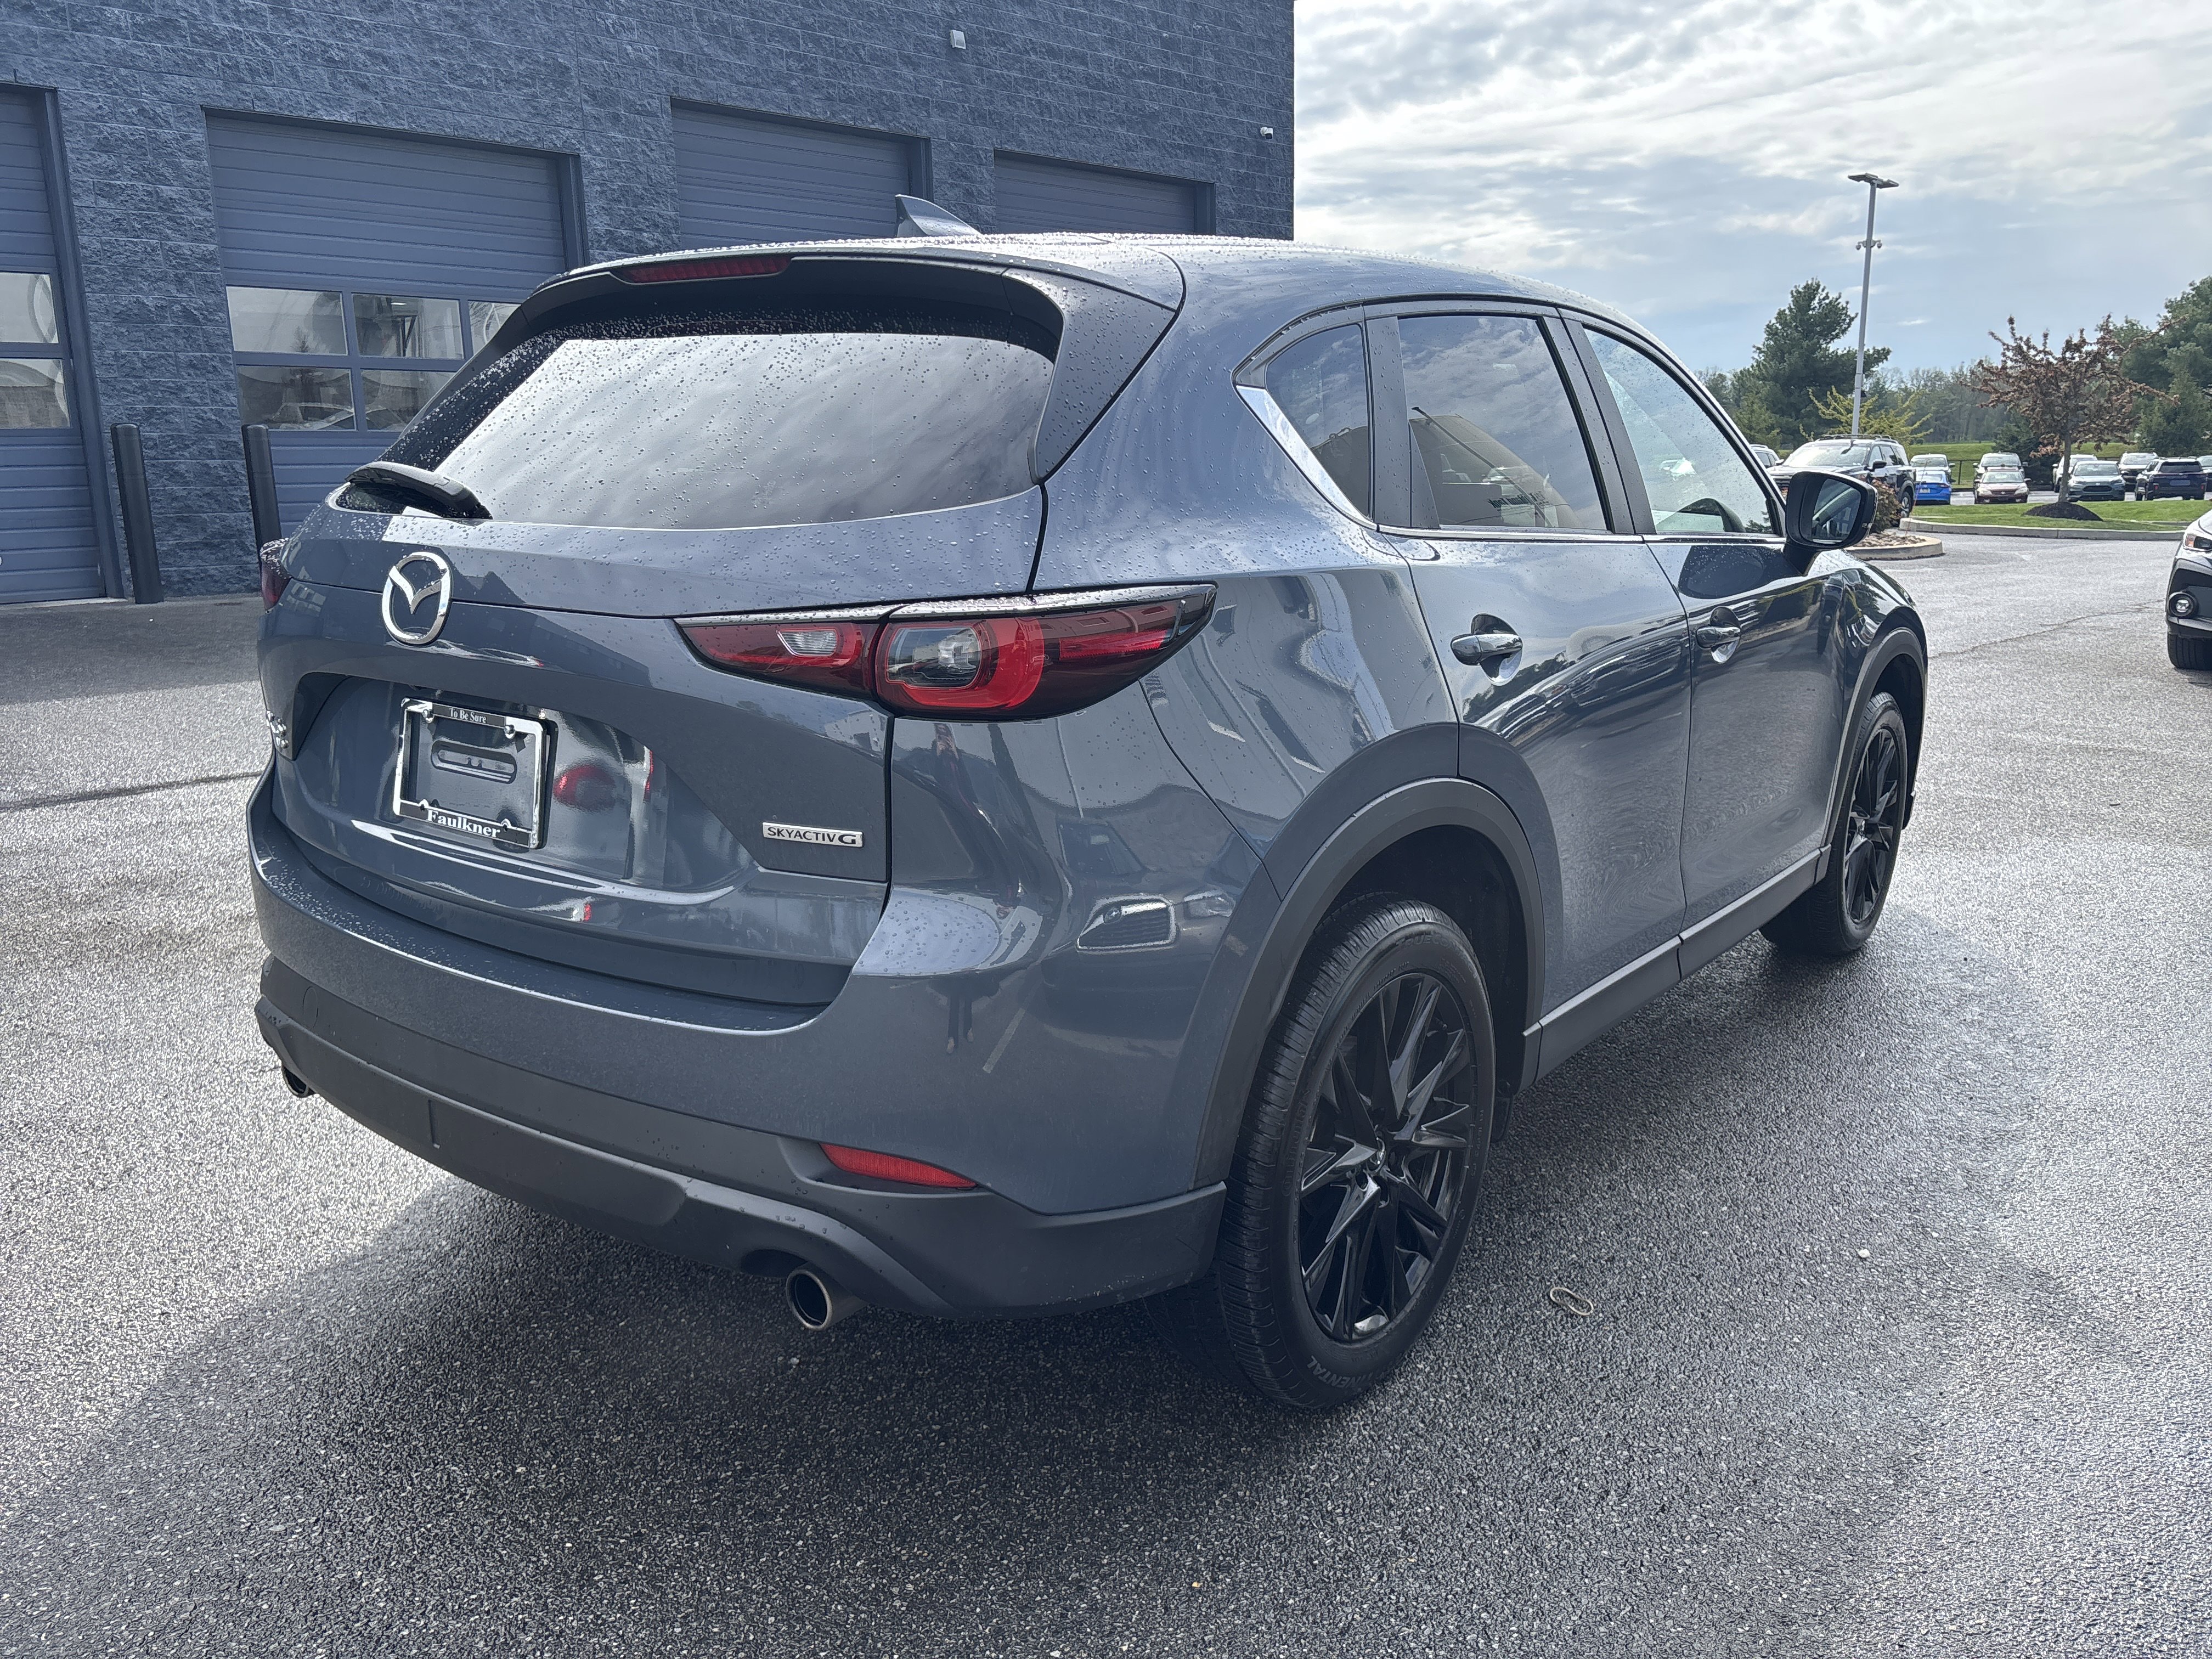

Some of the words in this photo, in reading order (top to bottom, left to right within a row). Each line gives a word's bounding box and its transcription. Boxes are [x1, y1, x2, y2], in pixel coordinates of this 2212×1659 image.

[449, 708, 458, 718] To
[460, 710, 469, 720] Be
[470, 712, 487, 724] Sure
[426, 809, 501, 838] Faulkner
